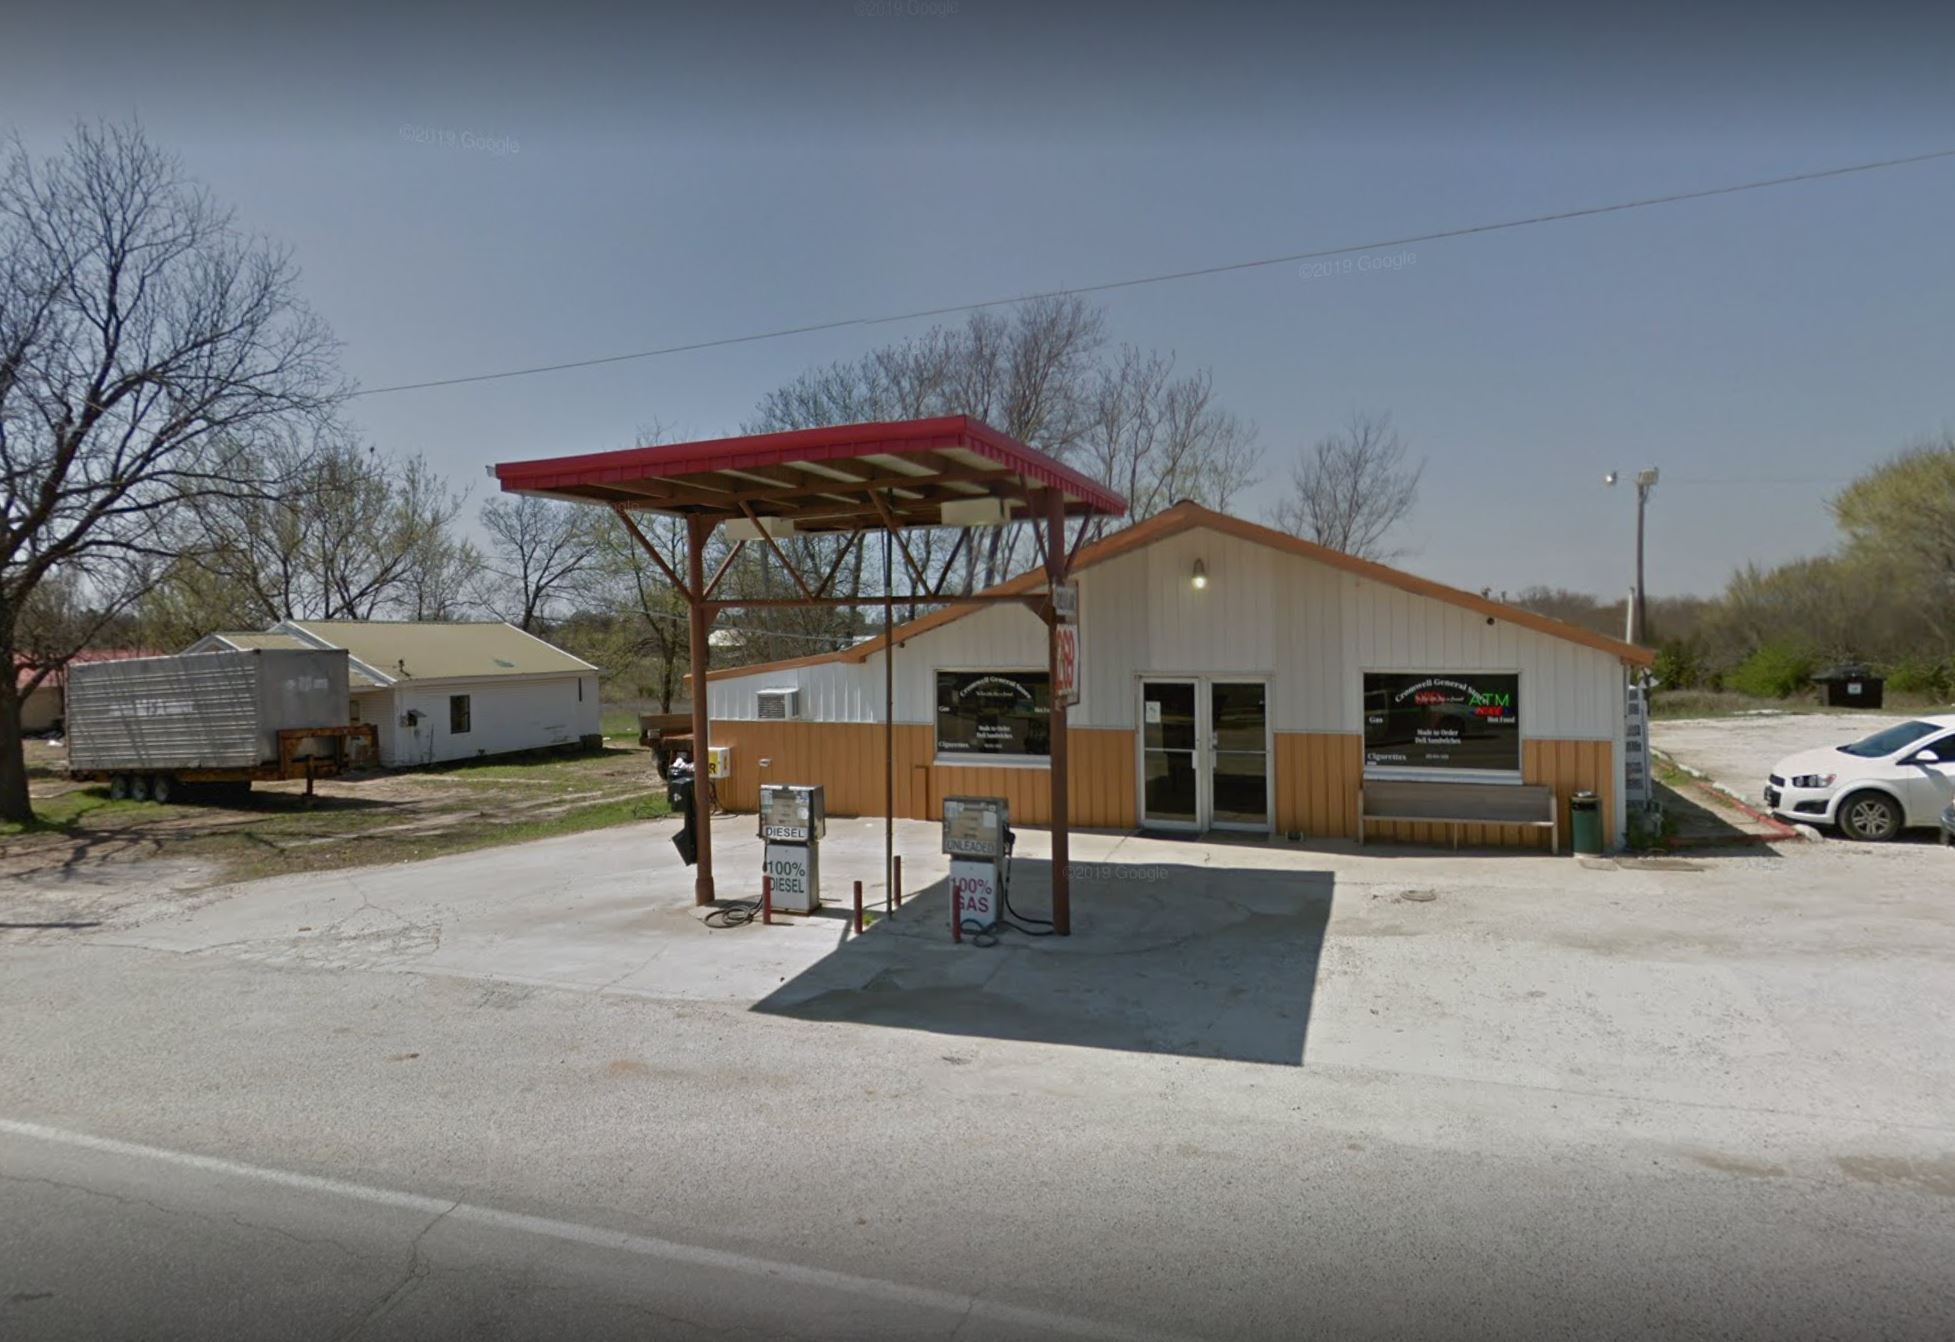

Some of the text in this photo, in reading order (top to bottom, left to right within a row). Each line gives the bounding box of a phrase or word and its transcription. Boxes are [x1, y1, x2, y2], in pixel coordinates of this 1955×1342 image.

[1395, 678, 1432, 703] Cromwell
[1433, 678, 1467, 690] General
[1469, 693, 1510, 706] ATM
[1367, 753, 1407, 761] Cigarettes
[766, 826, 805, 838] DIESEL
[767, 861, 806, 877] 100%
